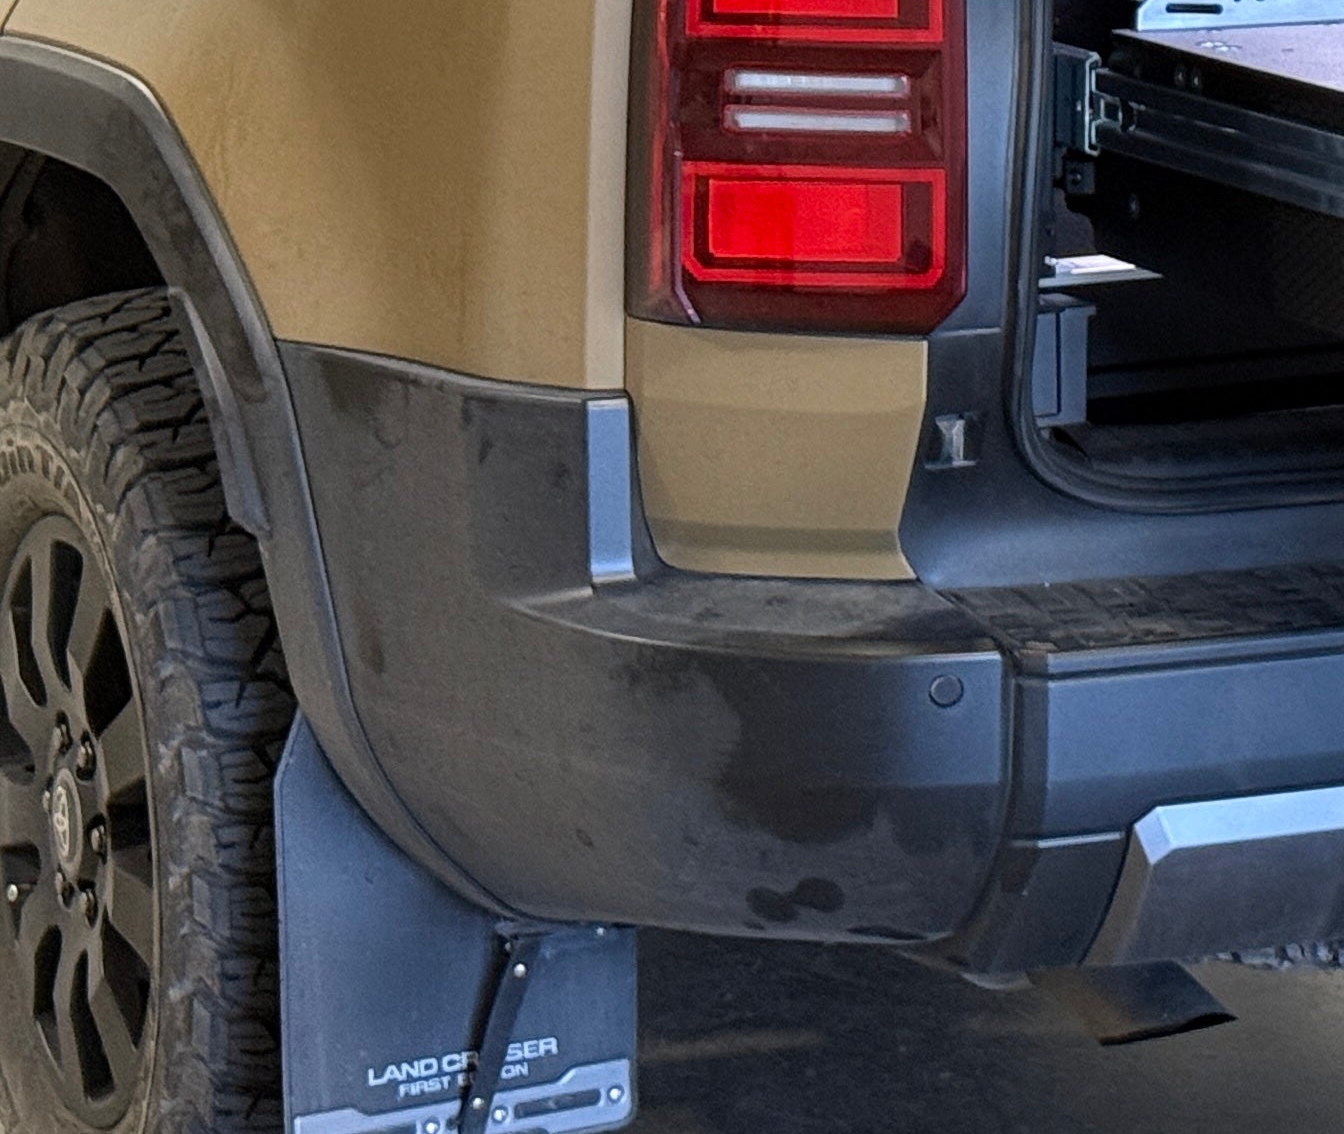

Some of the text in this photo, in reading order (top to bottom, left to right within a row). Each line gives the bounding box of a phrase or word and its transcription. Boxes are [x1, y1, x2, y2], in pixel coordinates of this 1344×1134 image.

[368, 1057, 440, 1087] LAND
[442, 1037, 559, 1073] CRSER
[399, 1075, 451, 1098] FIRST
